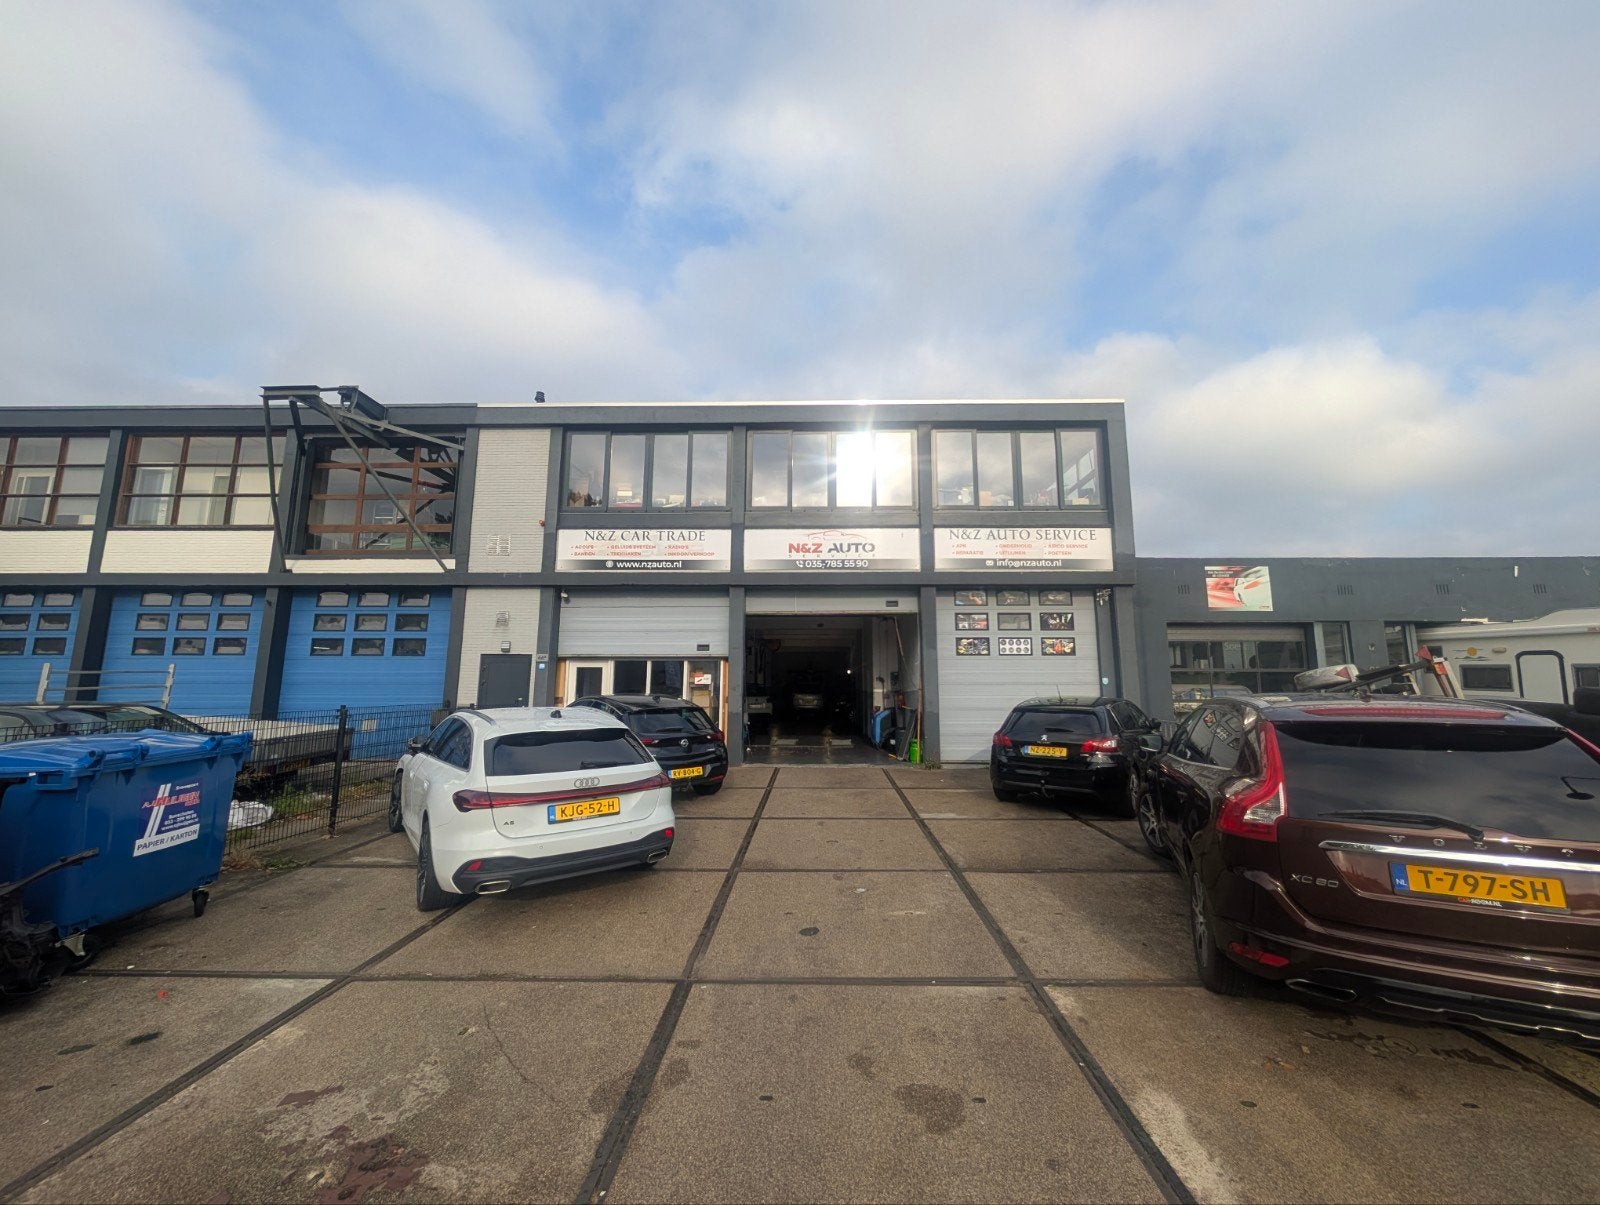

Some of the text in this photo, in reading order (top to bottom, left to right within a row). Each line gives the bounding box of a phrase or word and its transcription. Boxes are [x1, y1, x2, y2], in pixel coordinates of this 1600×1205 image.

[584, 530, 706, 542] N&Z CAR TRADE
[949, 529, 1097, 541] N&Z AUTO SERVICE
[788, 543, 876, 553] N&Z AUTO
[616, 560, 682, 569] www.nzauto.nl
[996, 559, 1062, 567] info@nzauto.nl
[560, 800, 615, 818] KJG-52-H
[137, 838, 165, 851] PAPIER
[170, 829, 198, 842] KARTON
[1418, 869, 1551, 902] T-797-SH
